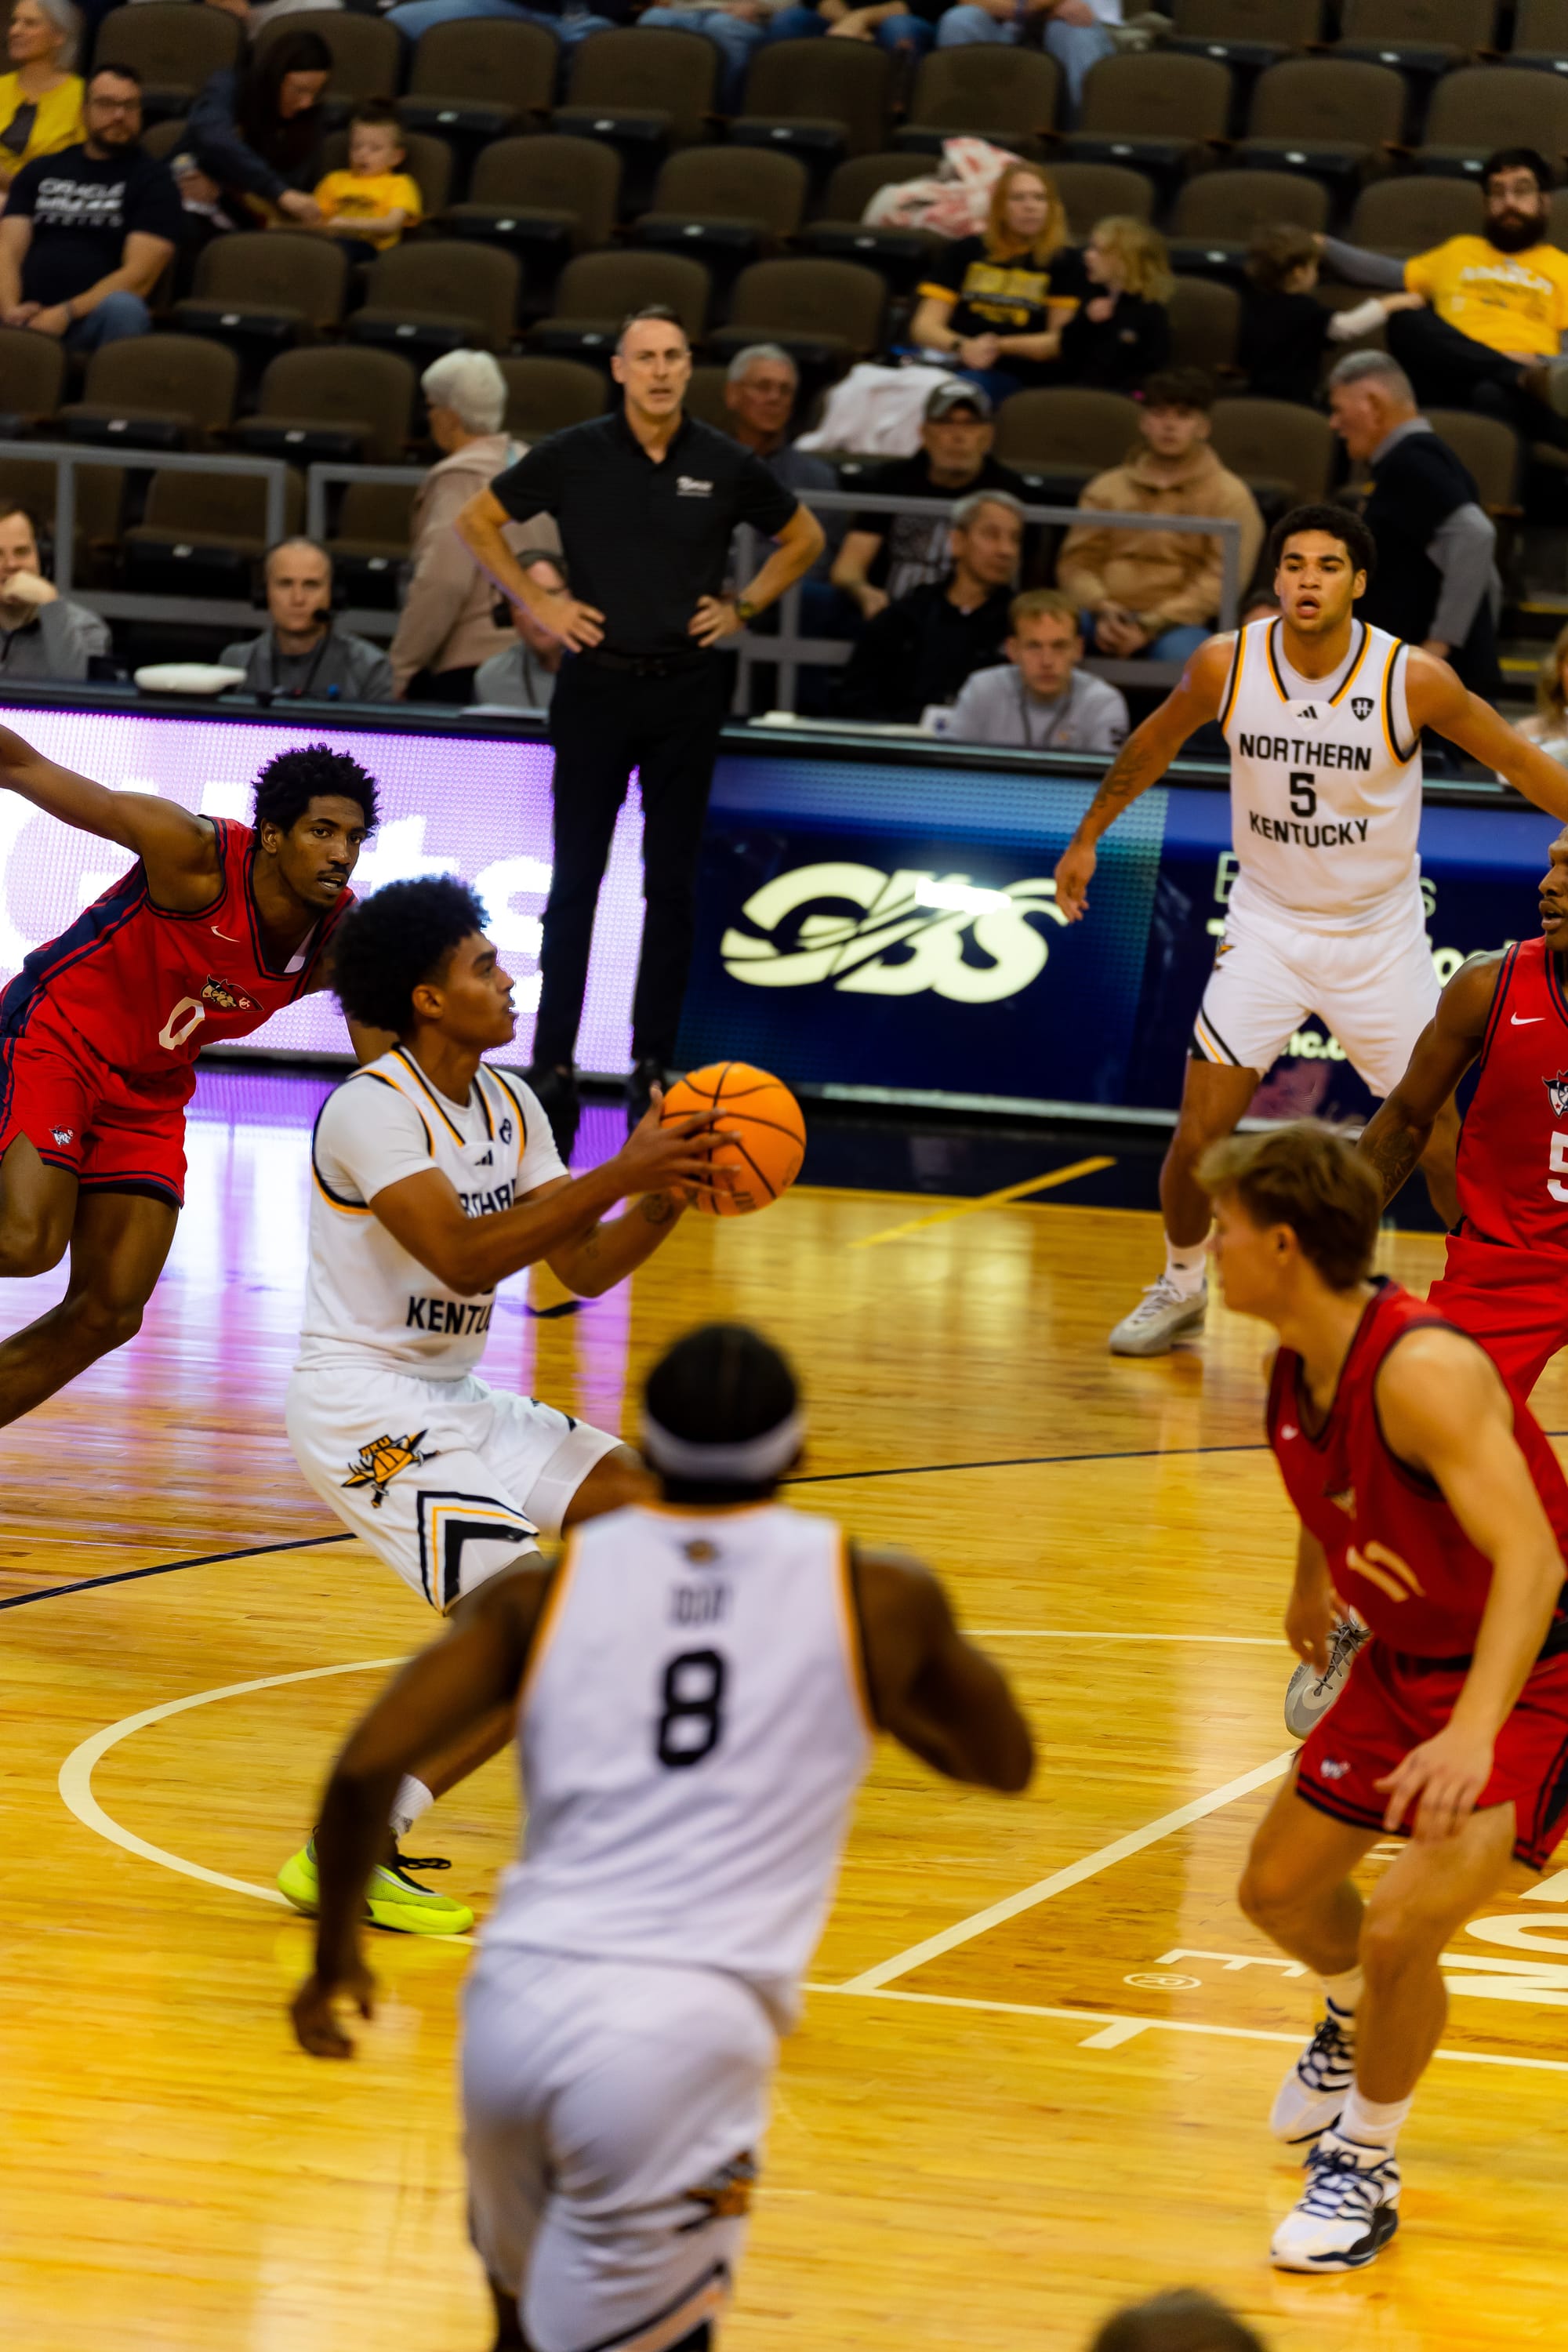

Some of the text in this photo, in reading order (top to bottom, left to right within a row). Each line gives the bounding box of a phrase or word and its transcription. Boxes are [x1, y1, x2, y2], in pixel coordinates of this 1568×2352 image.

[1240, 732, 1372, 771] NORTHERN
[1290, 772, 1316, 818] 5
[1249, 810, 1368, 848] KENTUCKY
[158, 996, 205, 1051] 0
[360, 1435, 392, 1458] NKU
[659, 1650, 724, 1767] 8
